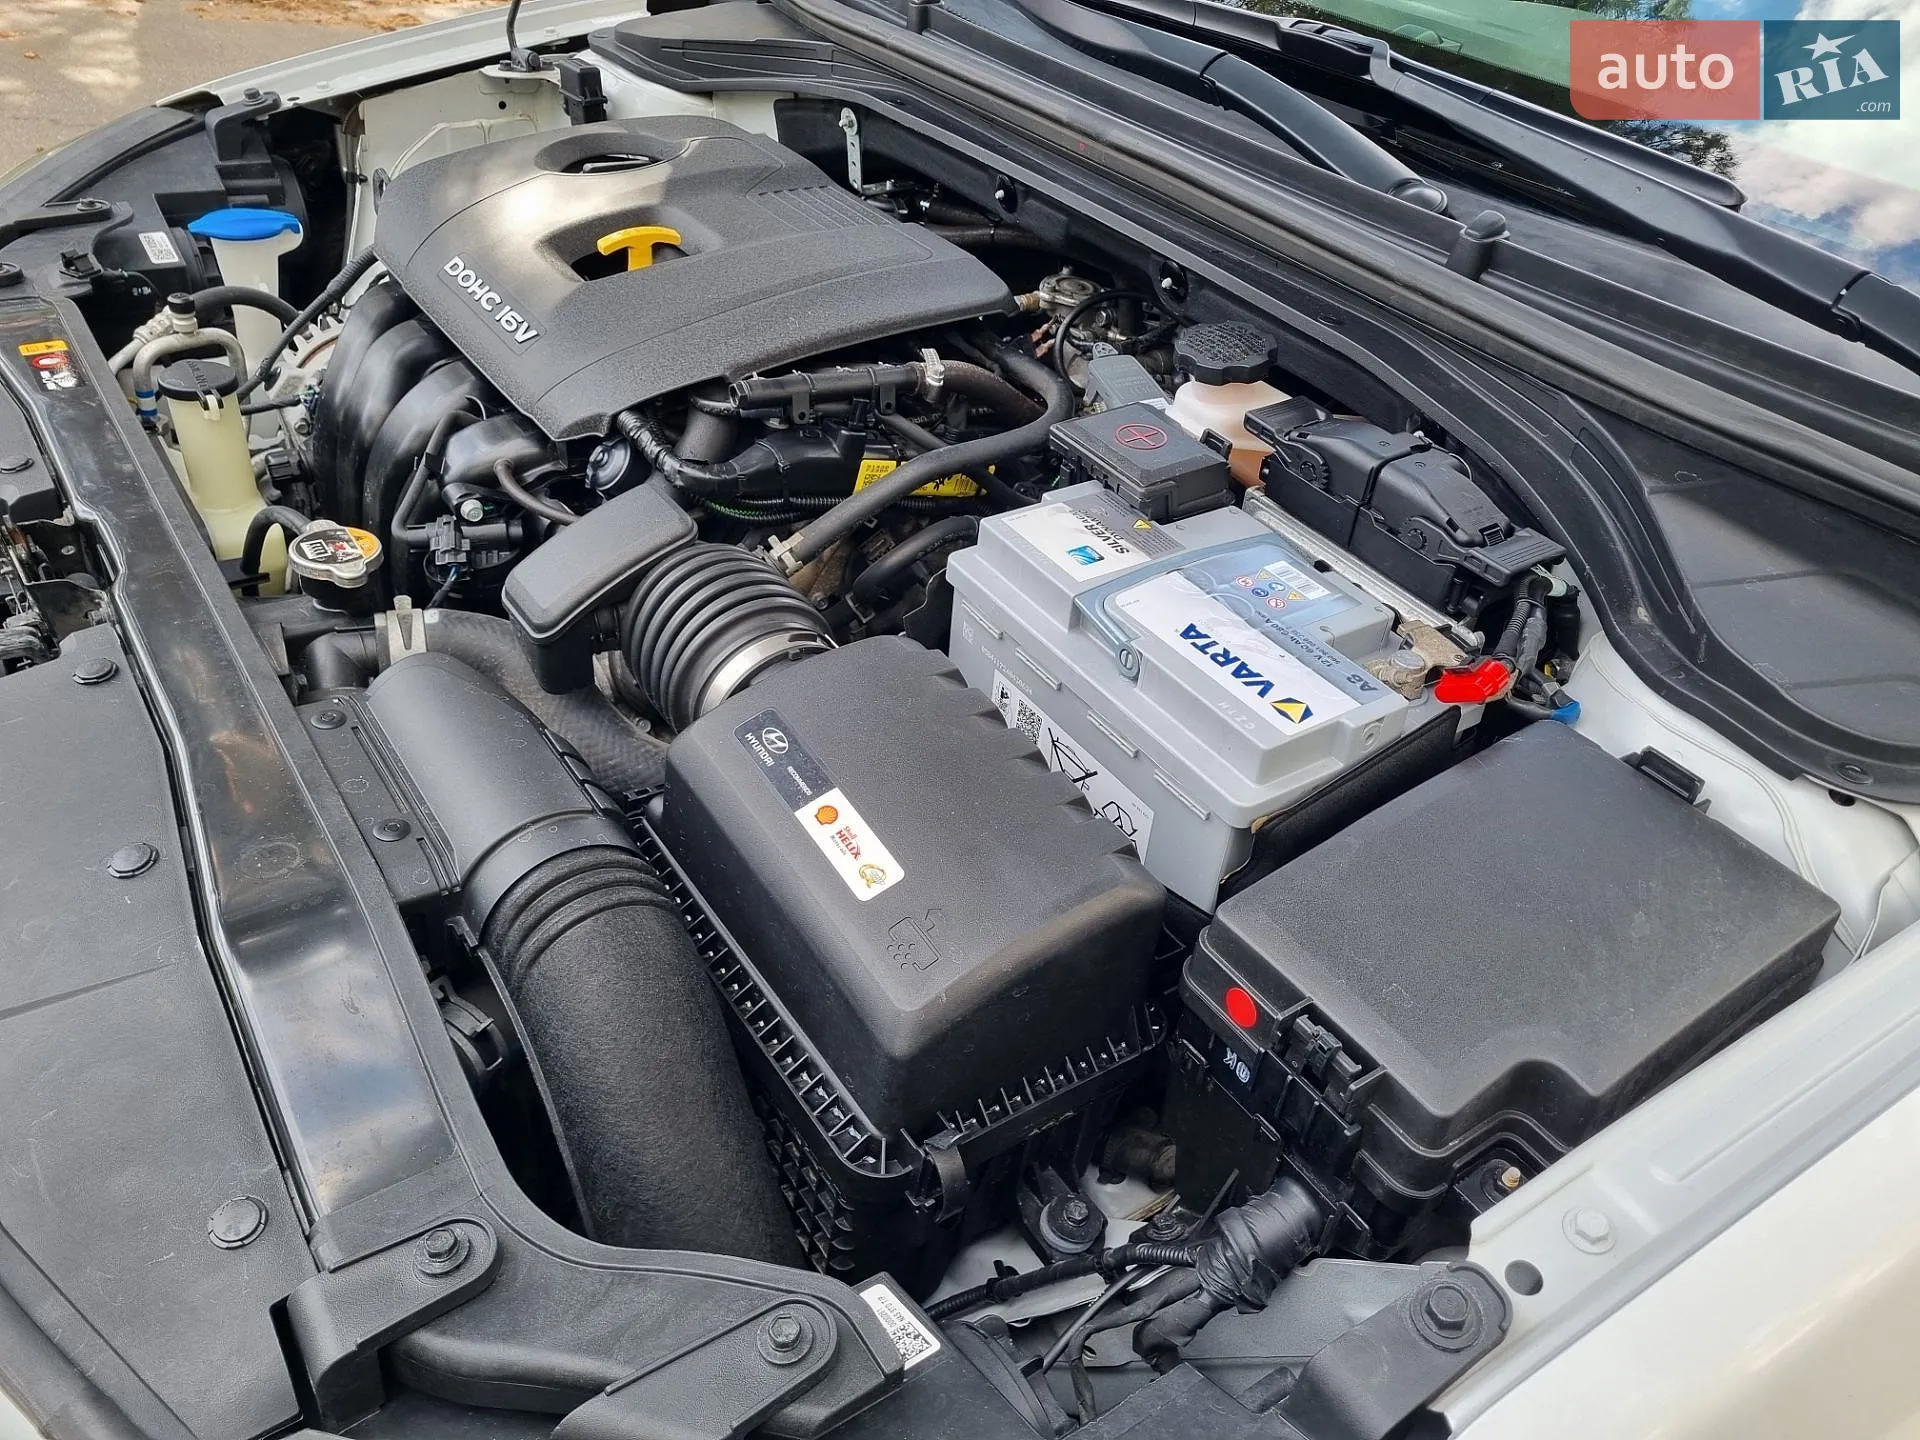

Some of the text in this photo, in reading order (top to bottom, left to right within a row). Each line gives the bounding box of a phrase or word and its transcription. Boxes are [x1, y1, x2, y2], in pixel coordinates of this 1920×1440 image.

[444, 256, 539, 344] DOHC 16V
[1084, 524, 1130, 554] SILVER
[1180, 623, 1275, 698] VARTA
[745, 732, 775, 767] HYUNDAI
[836, 829, 861, 861] HELIX
